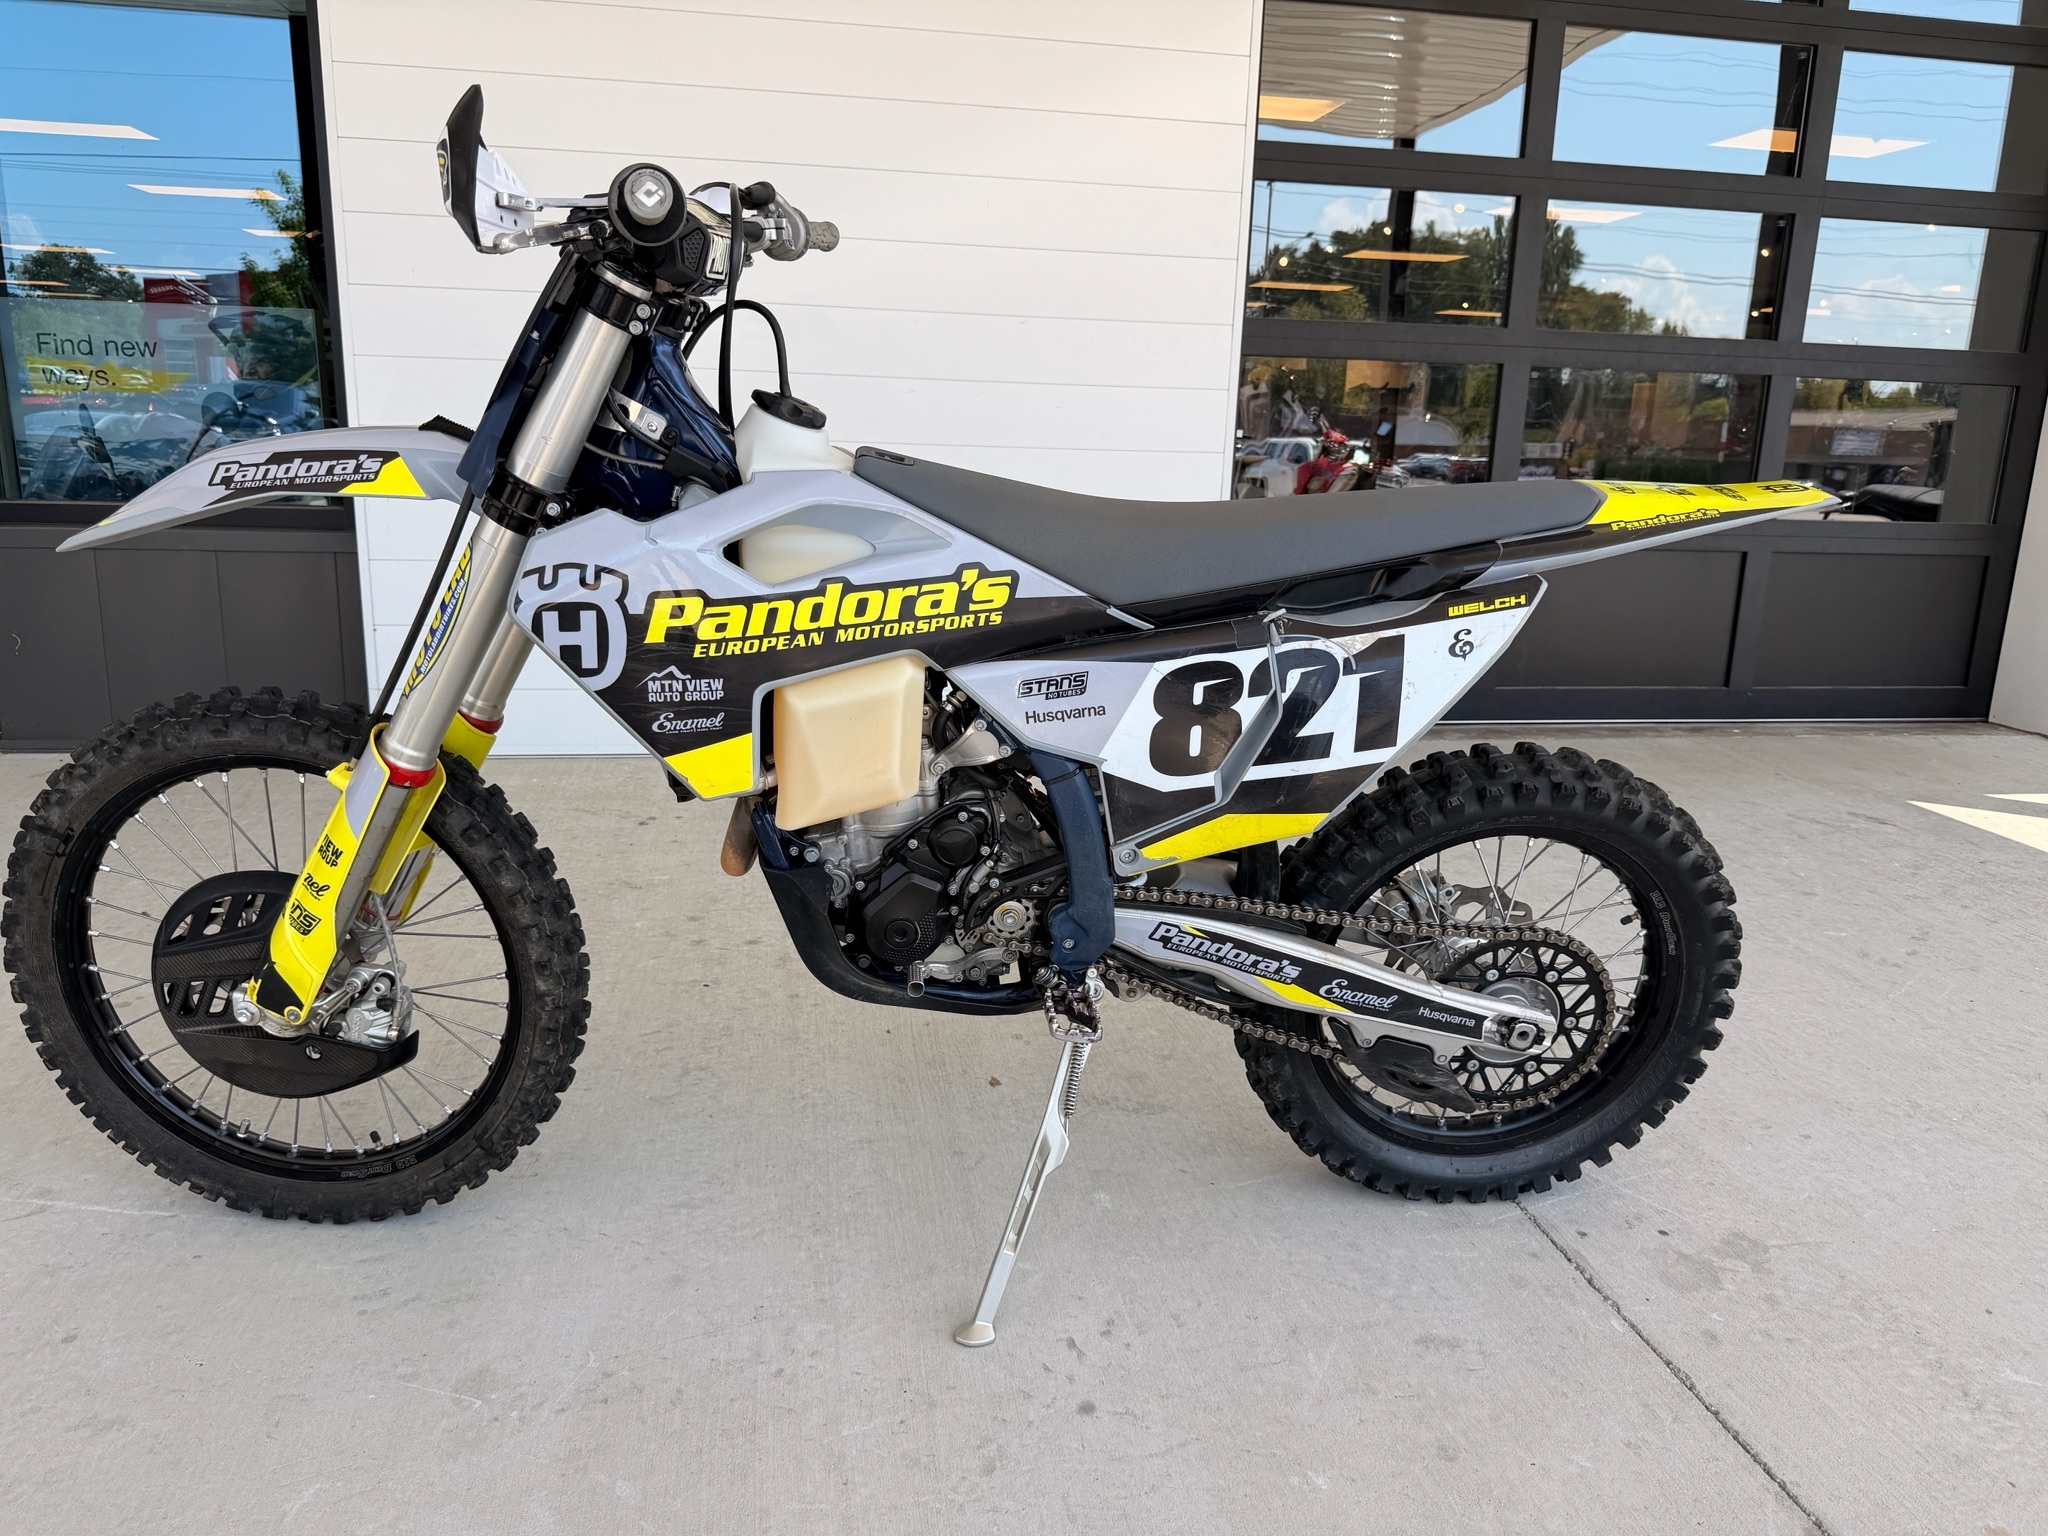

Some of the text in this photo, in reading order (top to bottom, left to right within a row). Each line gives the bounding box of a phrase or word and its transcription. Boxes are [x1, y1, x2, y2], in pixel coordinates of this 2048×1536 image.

[36, 332, 157, 358] Find new
[212, 454, 384, 485] Pandora's
[230, 472, 376, 489] EUROPEAN MOTORSPORTS
[1610, 508, 1719, 531] Pandora's
[643, 568, 1012, 644] Pandora's
[1448, 594, 1526, 617] WELCH
[692, 611, 1003, 658] EUROPEAN MOTORSPORTS
[647, 678, 724, 692] MTN VIEW
[648, 691, 724, 702] AUTO GROUP
[1020, 674, 1086, 696] STANS
[1025, 705, 1106, 724] Husqvarna
[1149, 633, 1406, 777] 821
[651, 712, 725, 733] Enamel
[1150, 923, 1303, 979] Pandora's
[1166, 942, 1293, 984] EUROPEAN MOTORSPORTS
[1319, 978, 1398, 1009] Enamel
[1418, 1006, 1476, 1027] Husqvarna
